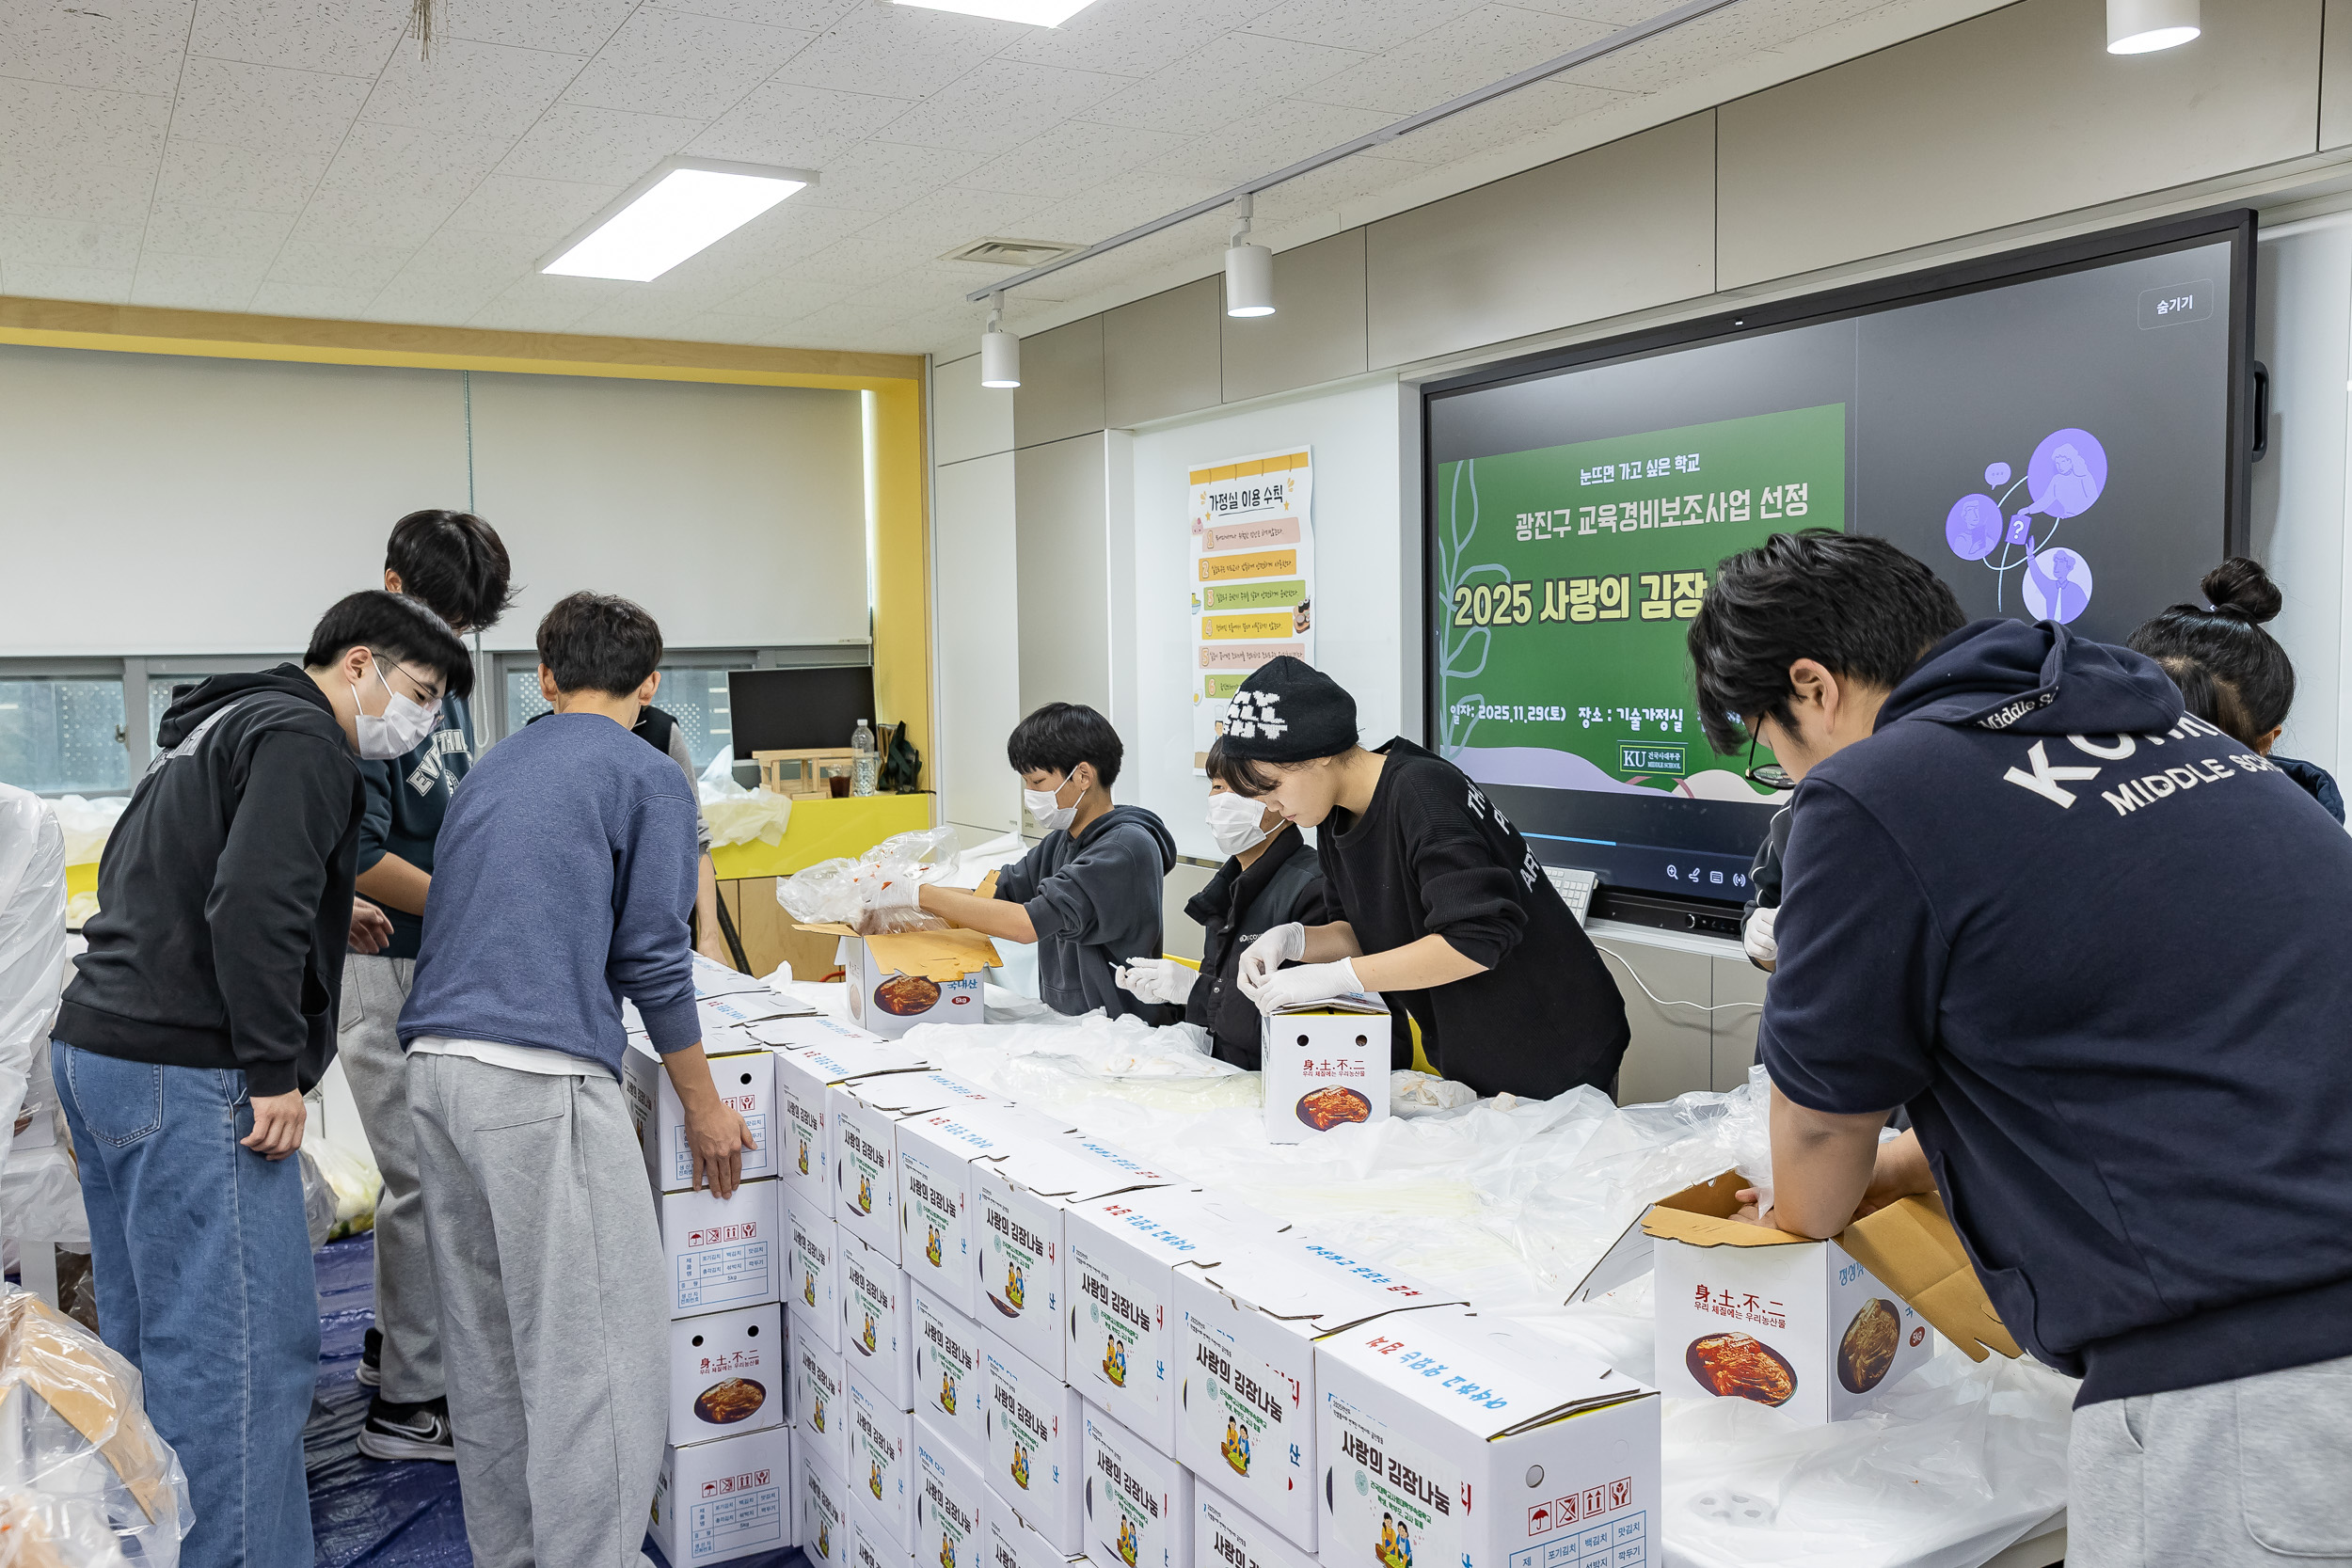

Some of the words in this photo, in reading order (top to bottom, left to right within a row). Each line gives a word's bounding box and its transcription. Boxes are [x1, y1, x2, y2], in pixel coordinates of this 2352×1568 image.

[2156, 293, 2194, 315] 숨기기
[1580, 466, 1614, 486] 눈뜨면
[1618, 463, 1642, 483] 가고
[1645, 457, 1671, 477] 싶은
[1674, 453, 1701, 473] 학교
[1209, 492, 1238, 512] 가정실
[1242, 489, 1261, 507] 이용
[1264, 485, 1283, 504] 수칙
[1516, 510, 1572, 542] 광진구
[1578, 488, 1751, 537] 교육경비보조사업
[1760, 483, 1809, 518] 선정
[1454, 583, 1534, 627] 2025
[1539, 575, 1630, 623] 사랑의
[1640, 570, 1708, 622] 김장
[1450, 705, 1475, 724] 일자:
[1579, 707, 1603, 729] 장소
[1616, 707, 1684, 733] 기술가정실
[1978, 701, 2035, 729] Middle
[1624, 751, 1646, 768] KU
[2101, 758, 2235, 816] MIDDLE
[946, 979, 978, 990] 국내산
[787, 1100, 799, 1117] 사랑의
[845, 1129, 861, 1152] 사랑의
[862, 1141, 884, 1168] 김장나눔
[910, 1176, 928, 1201] 사랑의
[930, 1188, 956, 1218] 김장나눔
[987, 1208, 1009, 1236] 사랑의
[1011, 1222, 1043, 1257] 김장나눔
[849, 1266, 865, 1290] 사랑의
[866, 1276, 888, 1309] 김장나눔
[1082, 1273, 1108, 1306] 사랑의
[1111, 1291, 1150, 1333] 김장나눔
[1693, 1302, 1708, 1312] 우리
[1712, 1303, 1743, 1321] 체질에는
[1745, 1312, 1786, 1329] 우리농산물
[924, 1321, 943, 1347] 사랑의
[946, 1338, 972, 1370] 김장나눔
[1197, 1343, 1231, 1385] 사랑의
[1234, 1369, 1282, 1423] 김장나눔
[994, 1384, 1015, 1416] 사랑의
[1017, 1402, 1048, 1442] 김장나눔
[857, 1411, 872, 1437] 사랑의
[873, 1430, 896, 1462] 김장나눔
[1097, 1449, 1120, 1486] 사랑의
[1123, 1471, 1158, 1519] 김장나눔
[1342, 1430, 1383, 1477] 사랑의
[1388, 1457, 1450, 1516] 김장나눔
[925, 1478, 944, 1508] 사랑의
[946, 1499, 971, 1535] 김장나눔
[1584, 1532, 1608, 1547] 백김치
[1618, 1521, 1641, 1537] 맛김치
[1548, 1543, 1577, 1560] 포기김치
[1618, 1545, 1641, 1560] 깍두기
